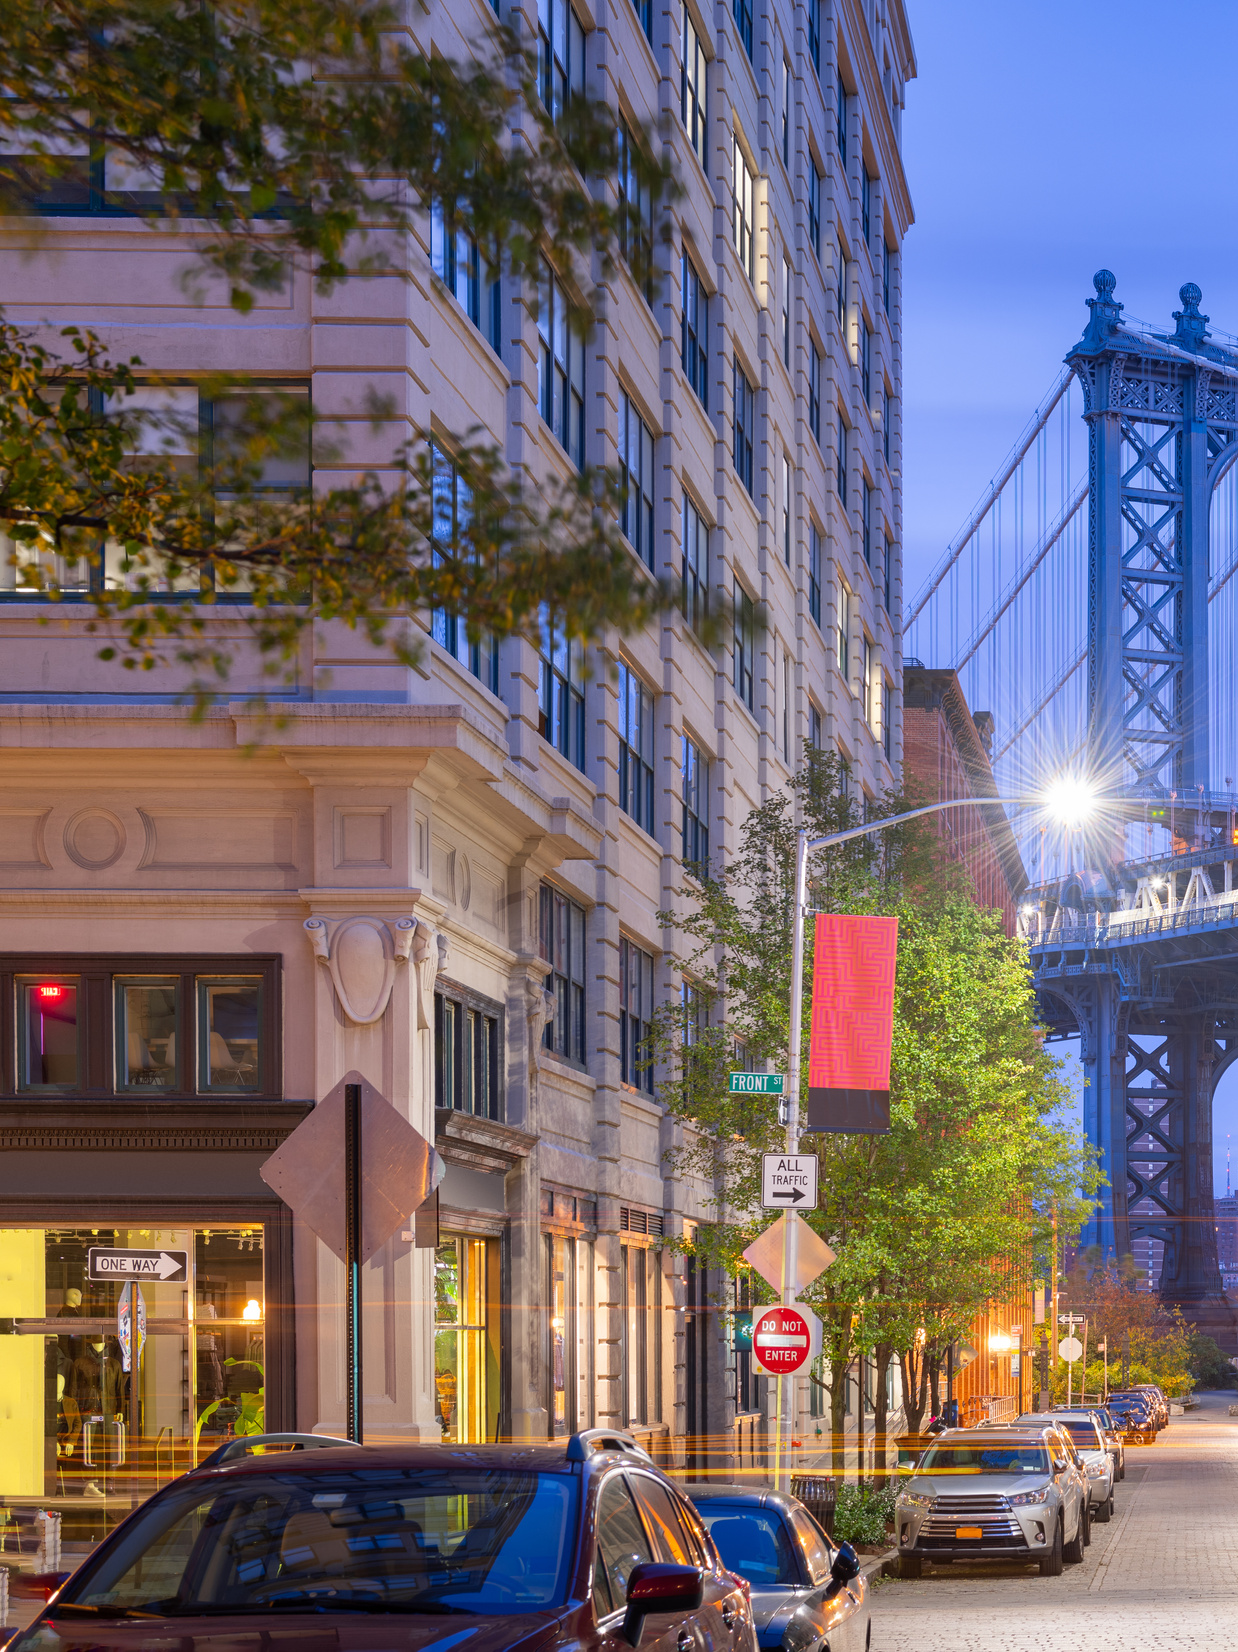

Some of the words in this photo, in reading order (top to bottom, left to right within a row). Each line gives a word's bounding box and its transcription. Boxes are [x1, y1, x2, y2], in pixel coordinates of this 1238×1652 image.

[732, 1075, 769, 1091] FRONT
[773, 1076, 783, 1085] ST
[777, 1159, 803, 1172] ALL
[771, 1174, 808, 1186] TRAFFIC
[101, 1258, 127, 1271] ONE
[132, 1259, 159, 1271] WAY
[762, 1320, 776, 1331] DO
[782, 1320, 802, 1332] NOT
[765, 1350, 798, 1361] ENTER
